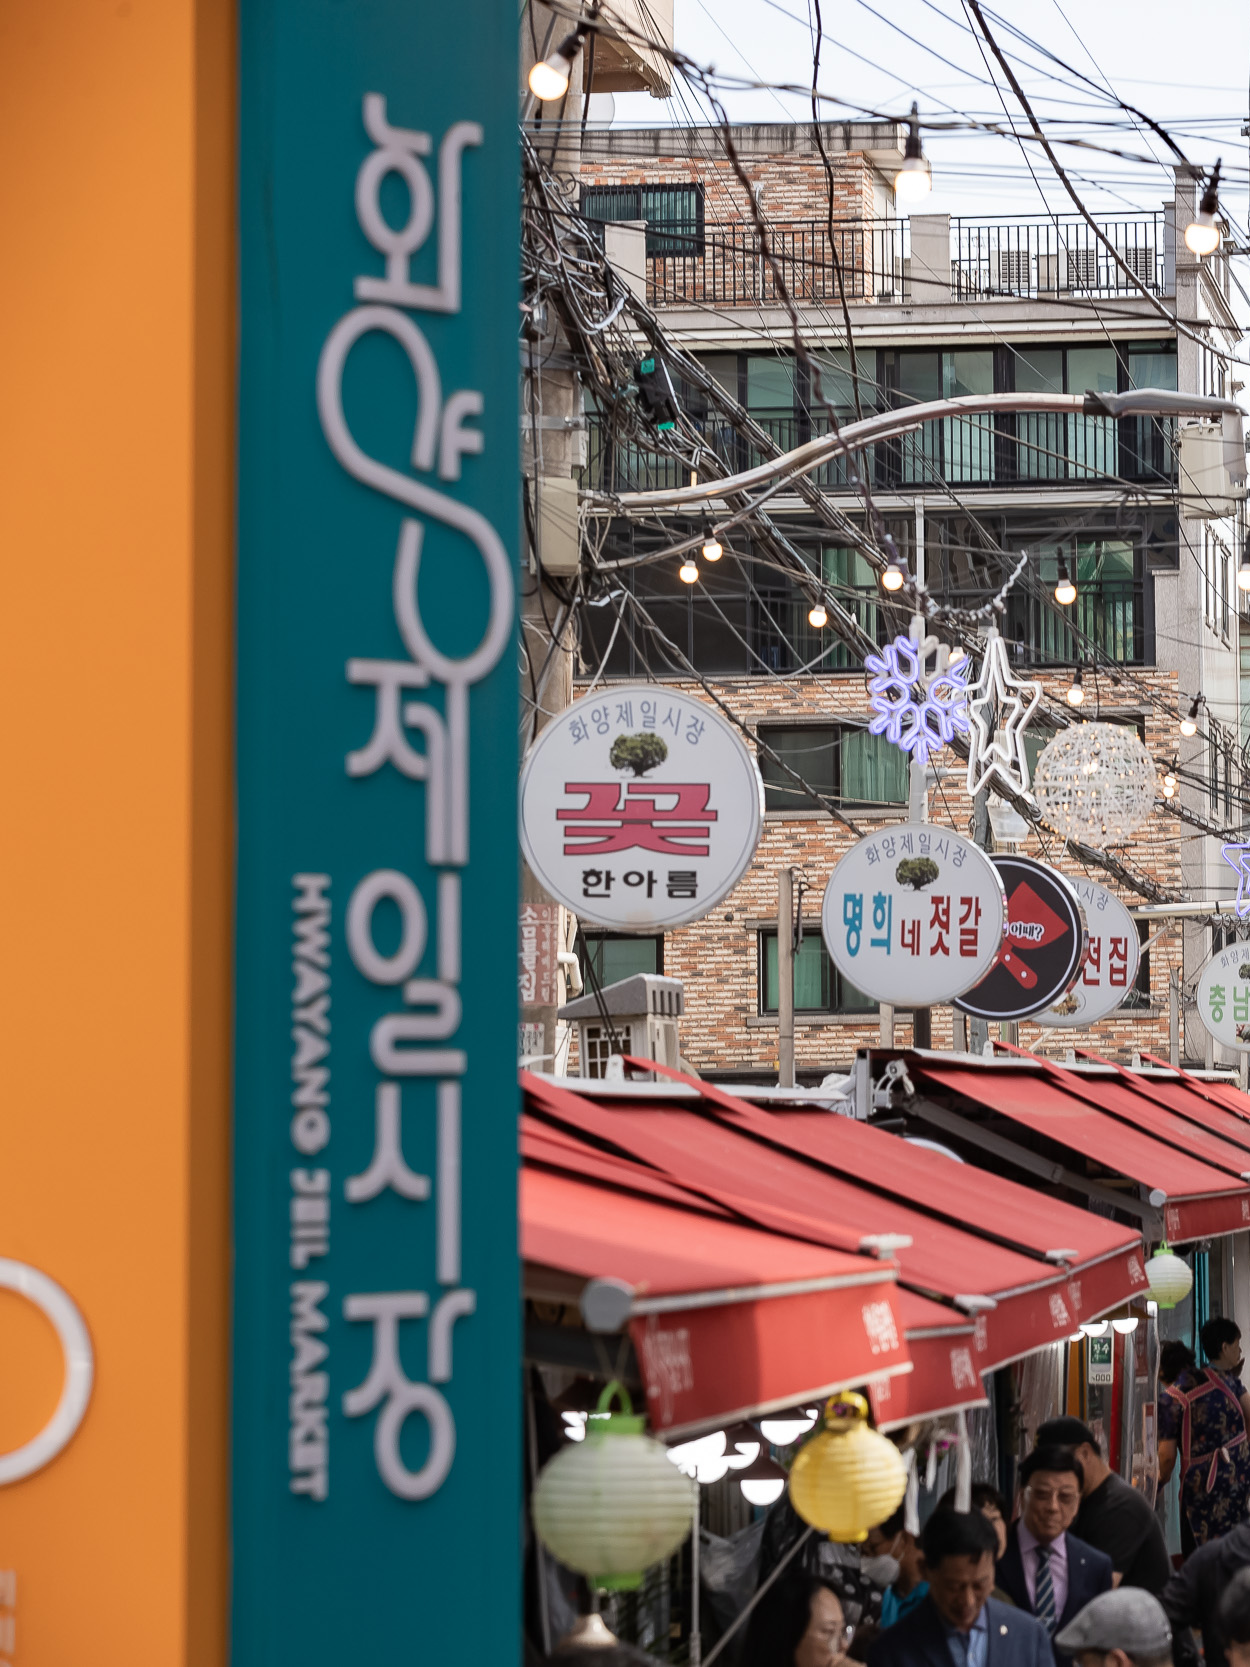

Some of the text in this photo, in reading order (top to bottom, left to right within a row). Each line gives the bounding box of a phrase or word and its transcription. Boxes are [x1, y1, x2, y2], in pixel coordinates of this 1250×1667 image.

[568, 700, 706, 747] 화양제일시장
[317, 92, 513, 1500] 화양제일시장
[556, 781, 718, 857] 꽃
[864, 832, 968, 869] 화양제일시장
[581, 868, 699, 900] 한아름
